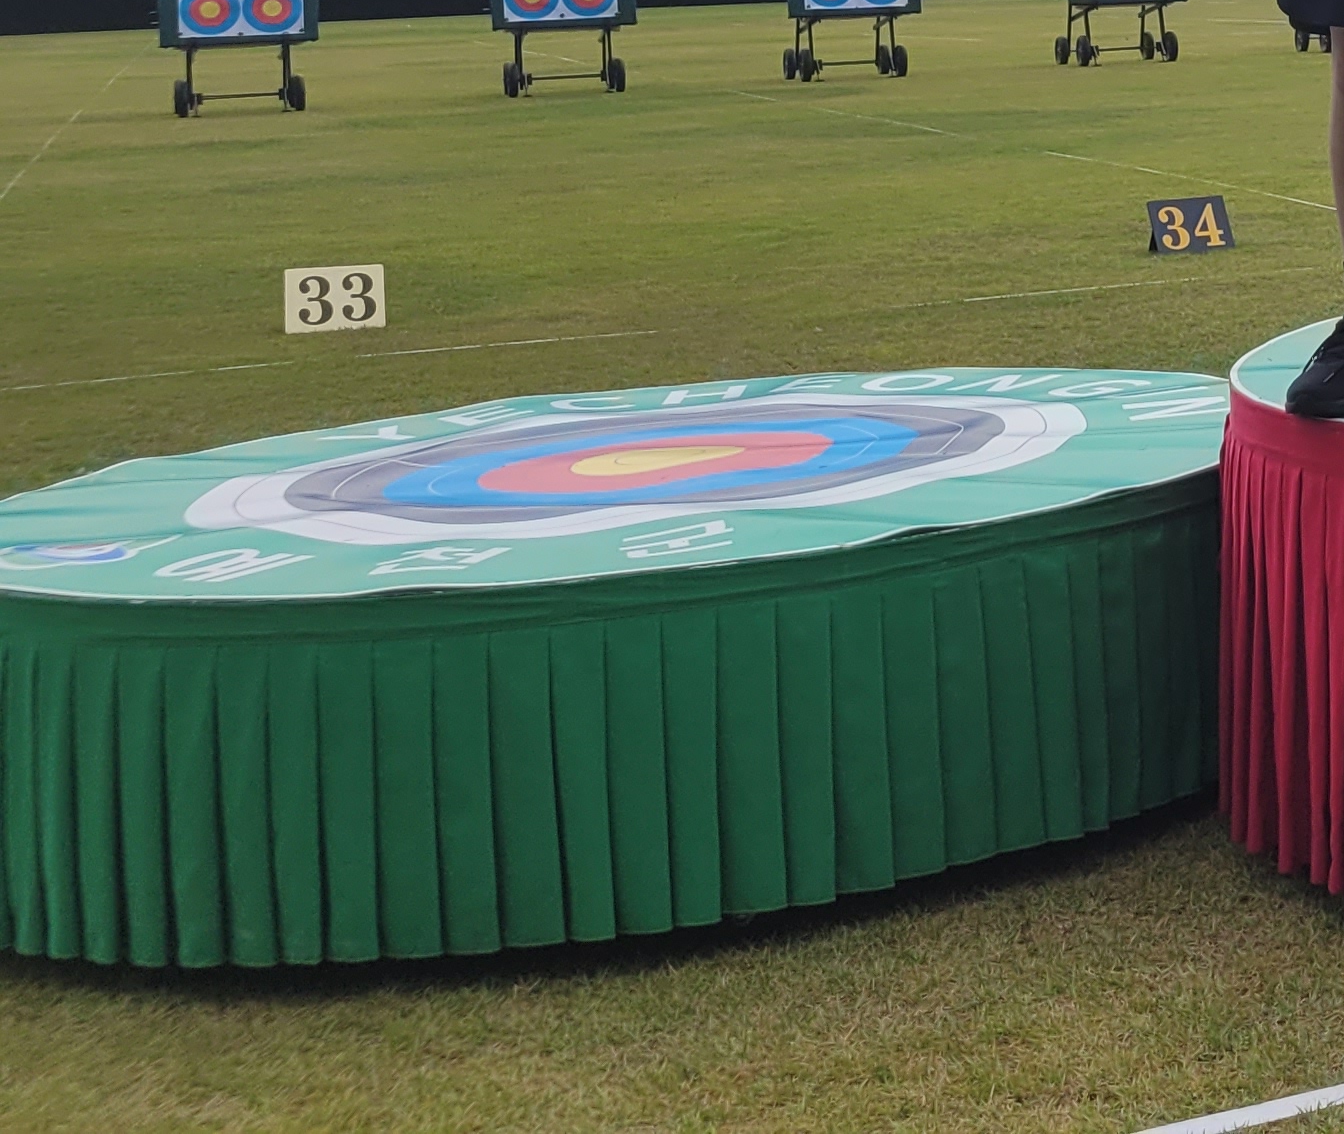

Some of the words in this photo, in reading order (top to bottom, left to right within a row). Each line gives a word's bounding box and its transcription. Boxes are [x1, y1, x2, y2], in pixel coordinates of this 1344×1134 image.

[1156, 203, 1225, 251] 34
[298, 272, 377, 326] 33
[318, 373, 1063, 441] YECHEON
